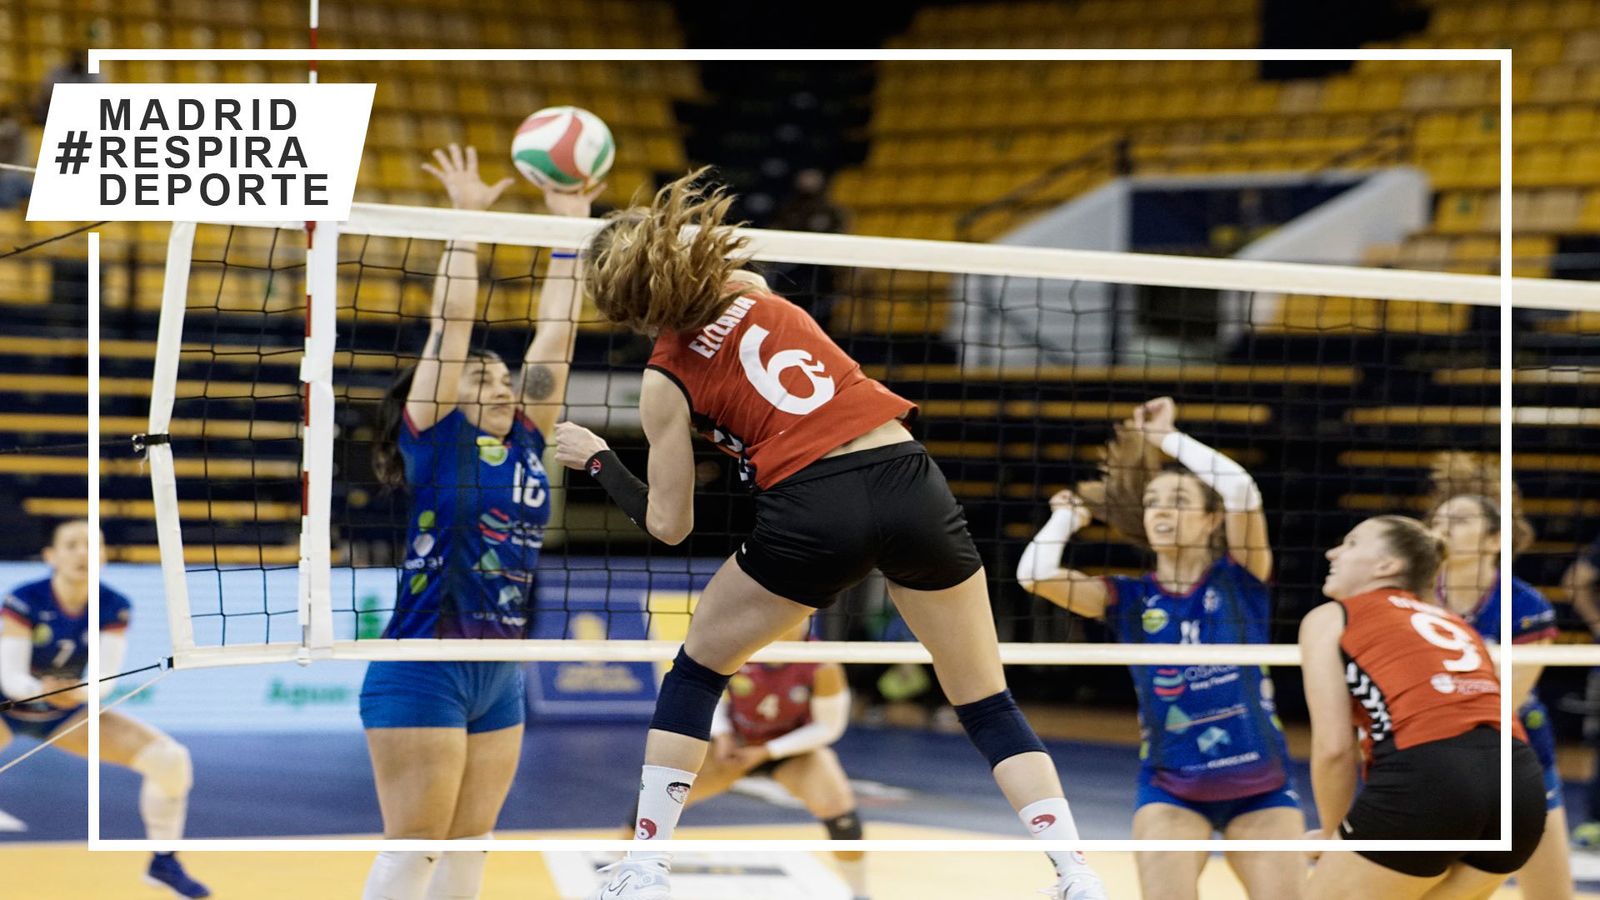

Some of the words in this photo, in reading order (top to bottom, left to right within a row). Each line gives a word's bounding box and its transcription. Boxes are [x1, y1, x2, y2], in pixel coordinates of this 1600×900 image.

[739, 324, 835, 415] 6
[54, 639, 75, 668] 7
[1410, 612, 1481, 672] 9
[757, 695, 780, 720] 4
